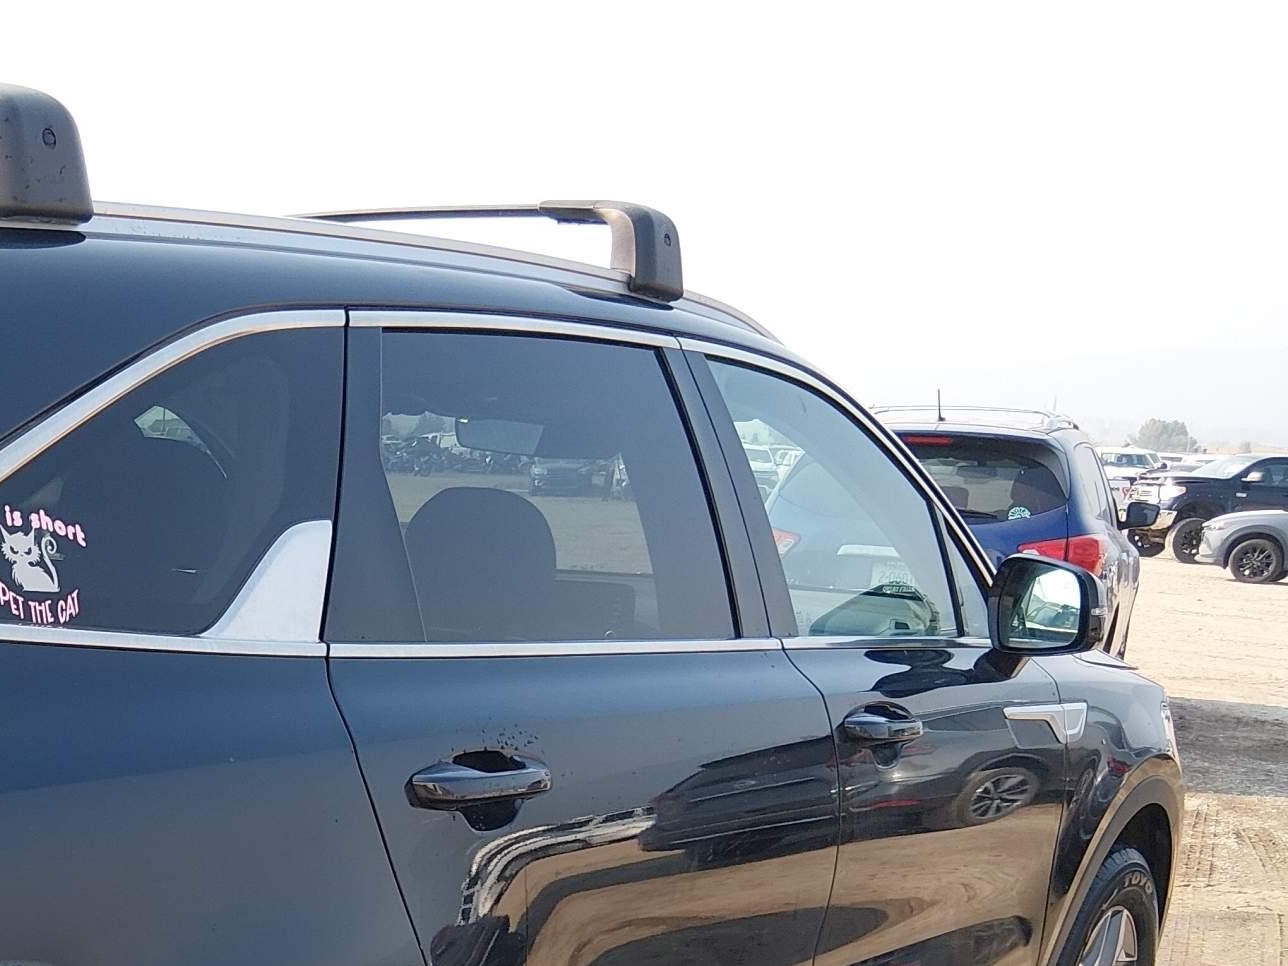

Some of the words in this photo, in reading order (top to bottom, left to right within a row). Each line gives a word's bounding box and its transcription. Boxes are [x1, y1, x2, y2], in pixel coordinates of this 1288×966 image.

[4, 504, 23, 527] is
[28, 509, 87, 548] short
[28, 599, 55, 625] THE
[57, 589, 79, 624] CAT
